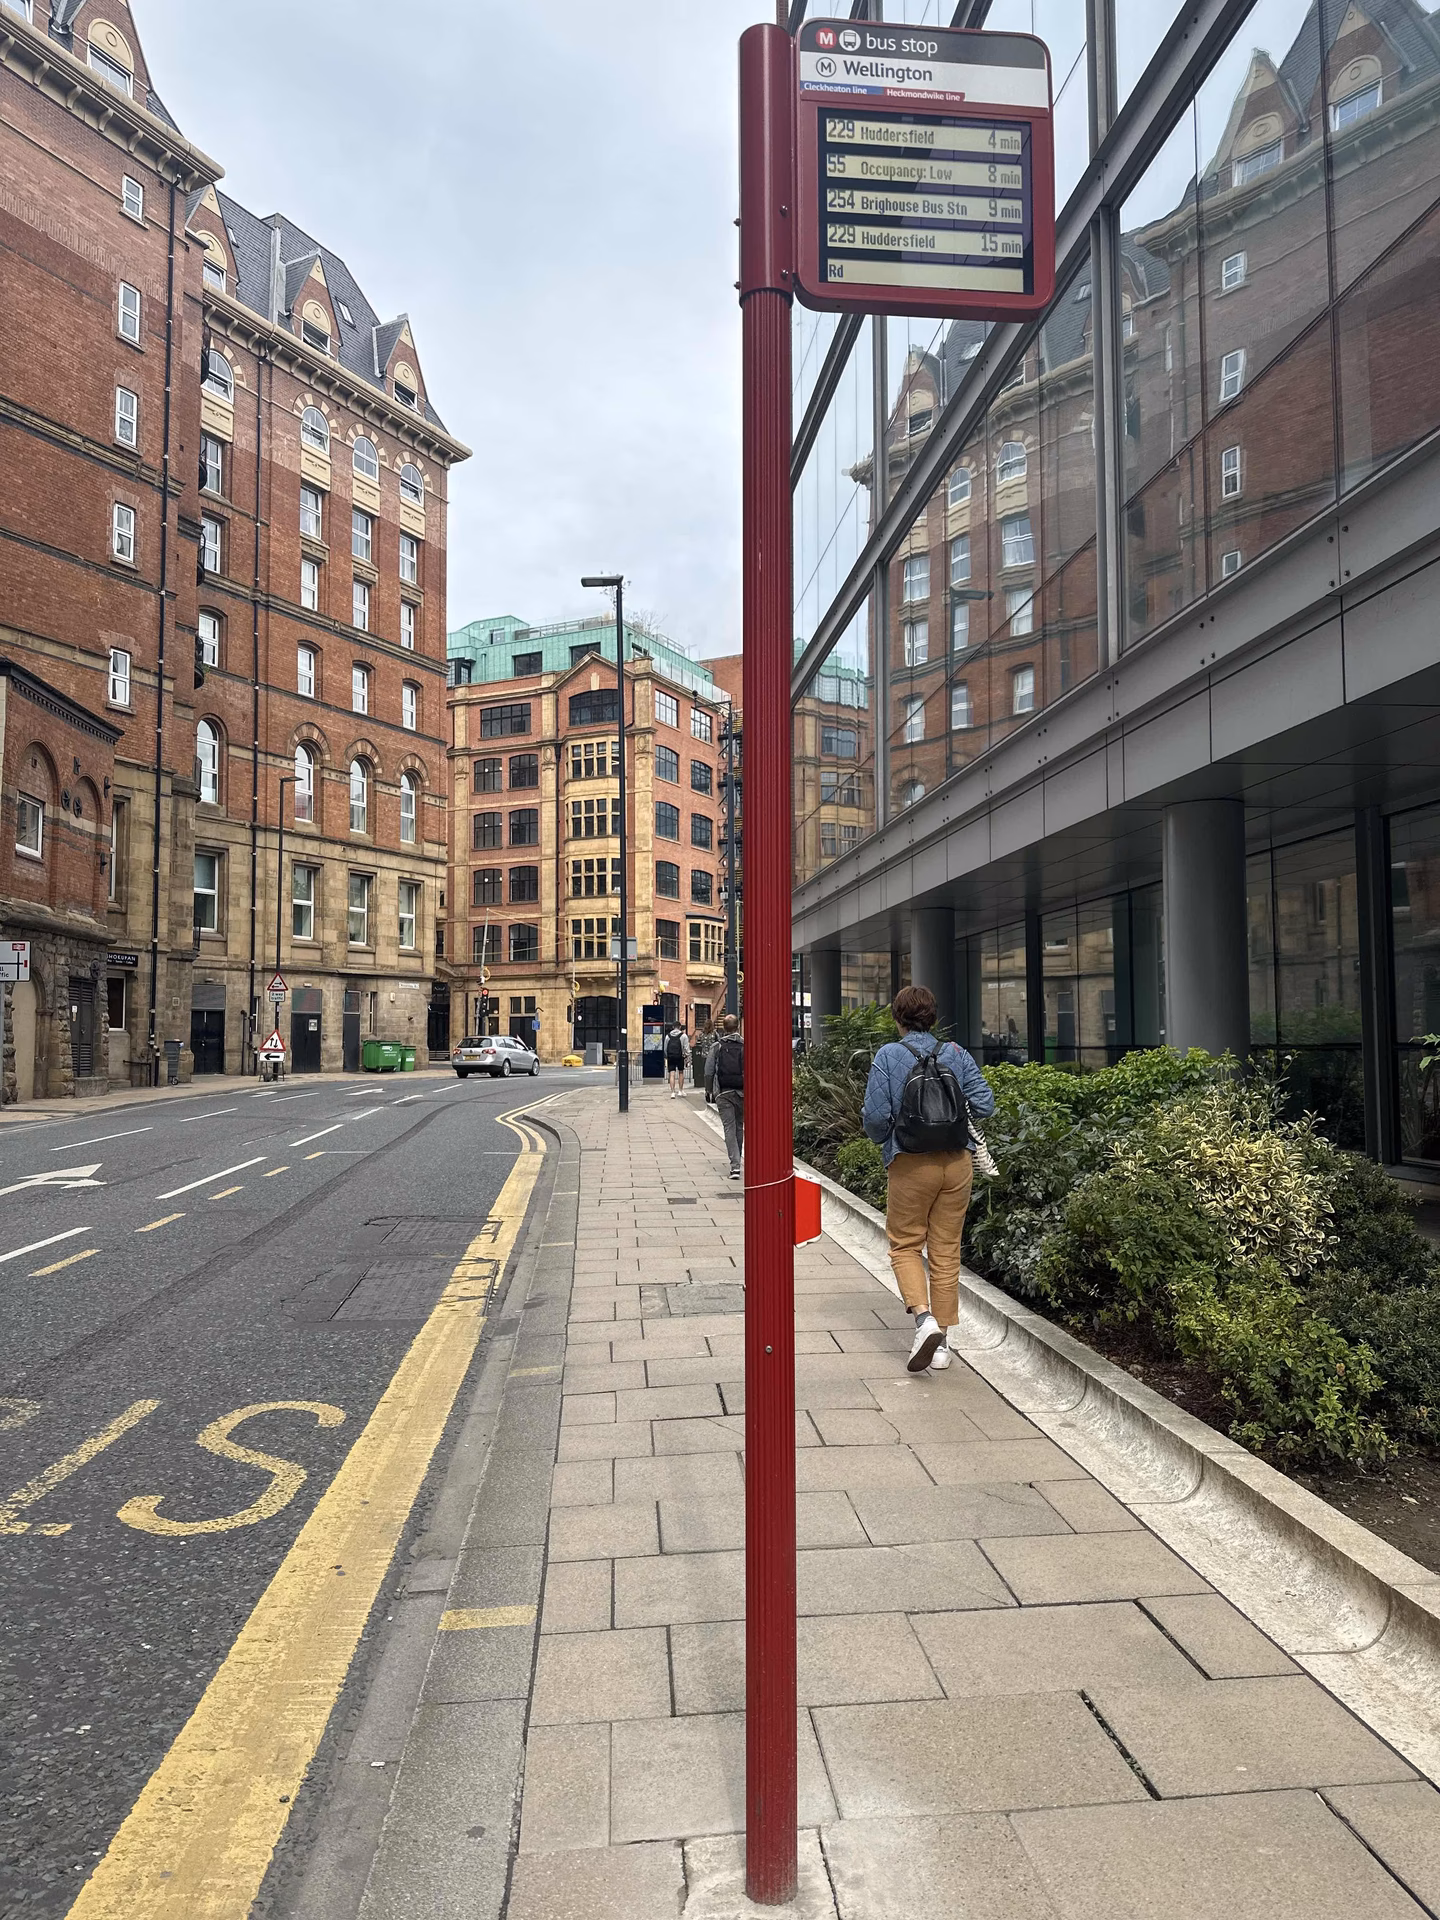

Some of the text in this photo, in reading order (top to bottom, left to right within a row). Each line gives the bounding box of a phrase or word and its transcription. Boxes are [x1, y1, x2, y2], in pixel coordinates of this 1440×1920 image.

[866, 33, 896, 51] bus
[902, 37, 938, 58] stop
[843, 60, 933, 82] Wellington
[804, 83, 867, 95] Cleckheaton line
[887, 89, 960, 101] Heckmondwike line
[828, 120, 1020, 151] 229 Huddersfield 4 min
[828, 155, 1021, 185] 55 Occupancy: Low 8 min
[828, 190, 1021, 220] 254 Brighouse Bus Stn 9 min
[829, 225, 1022, 254] 229 Huddersfield 15 min
[829, 264, 844, 278] Rd
